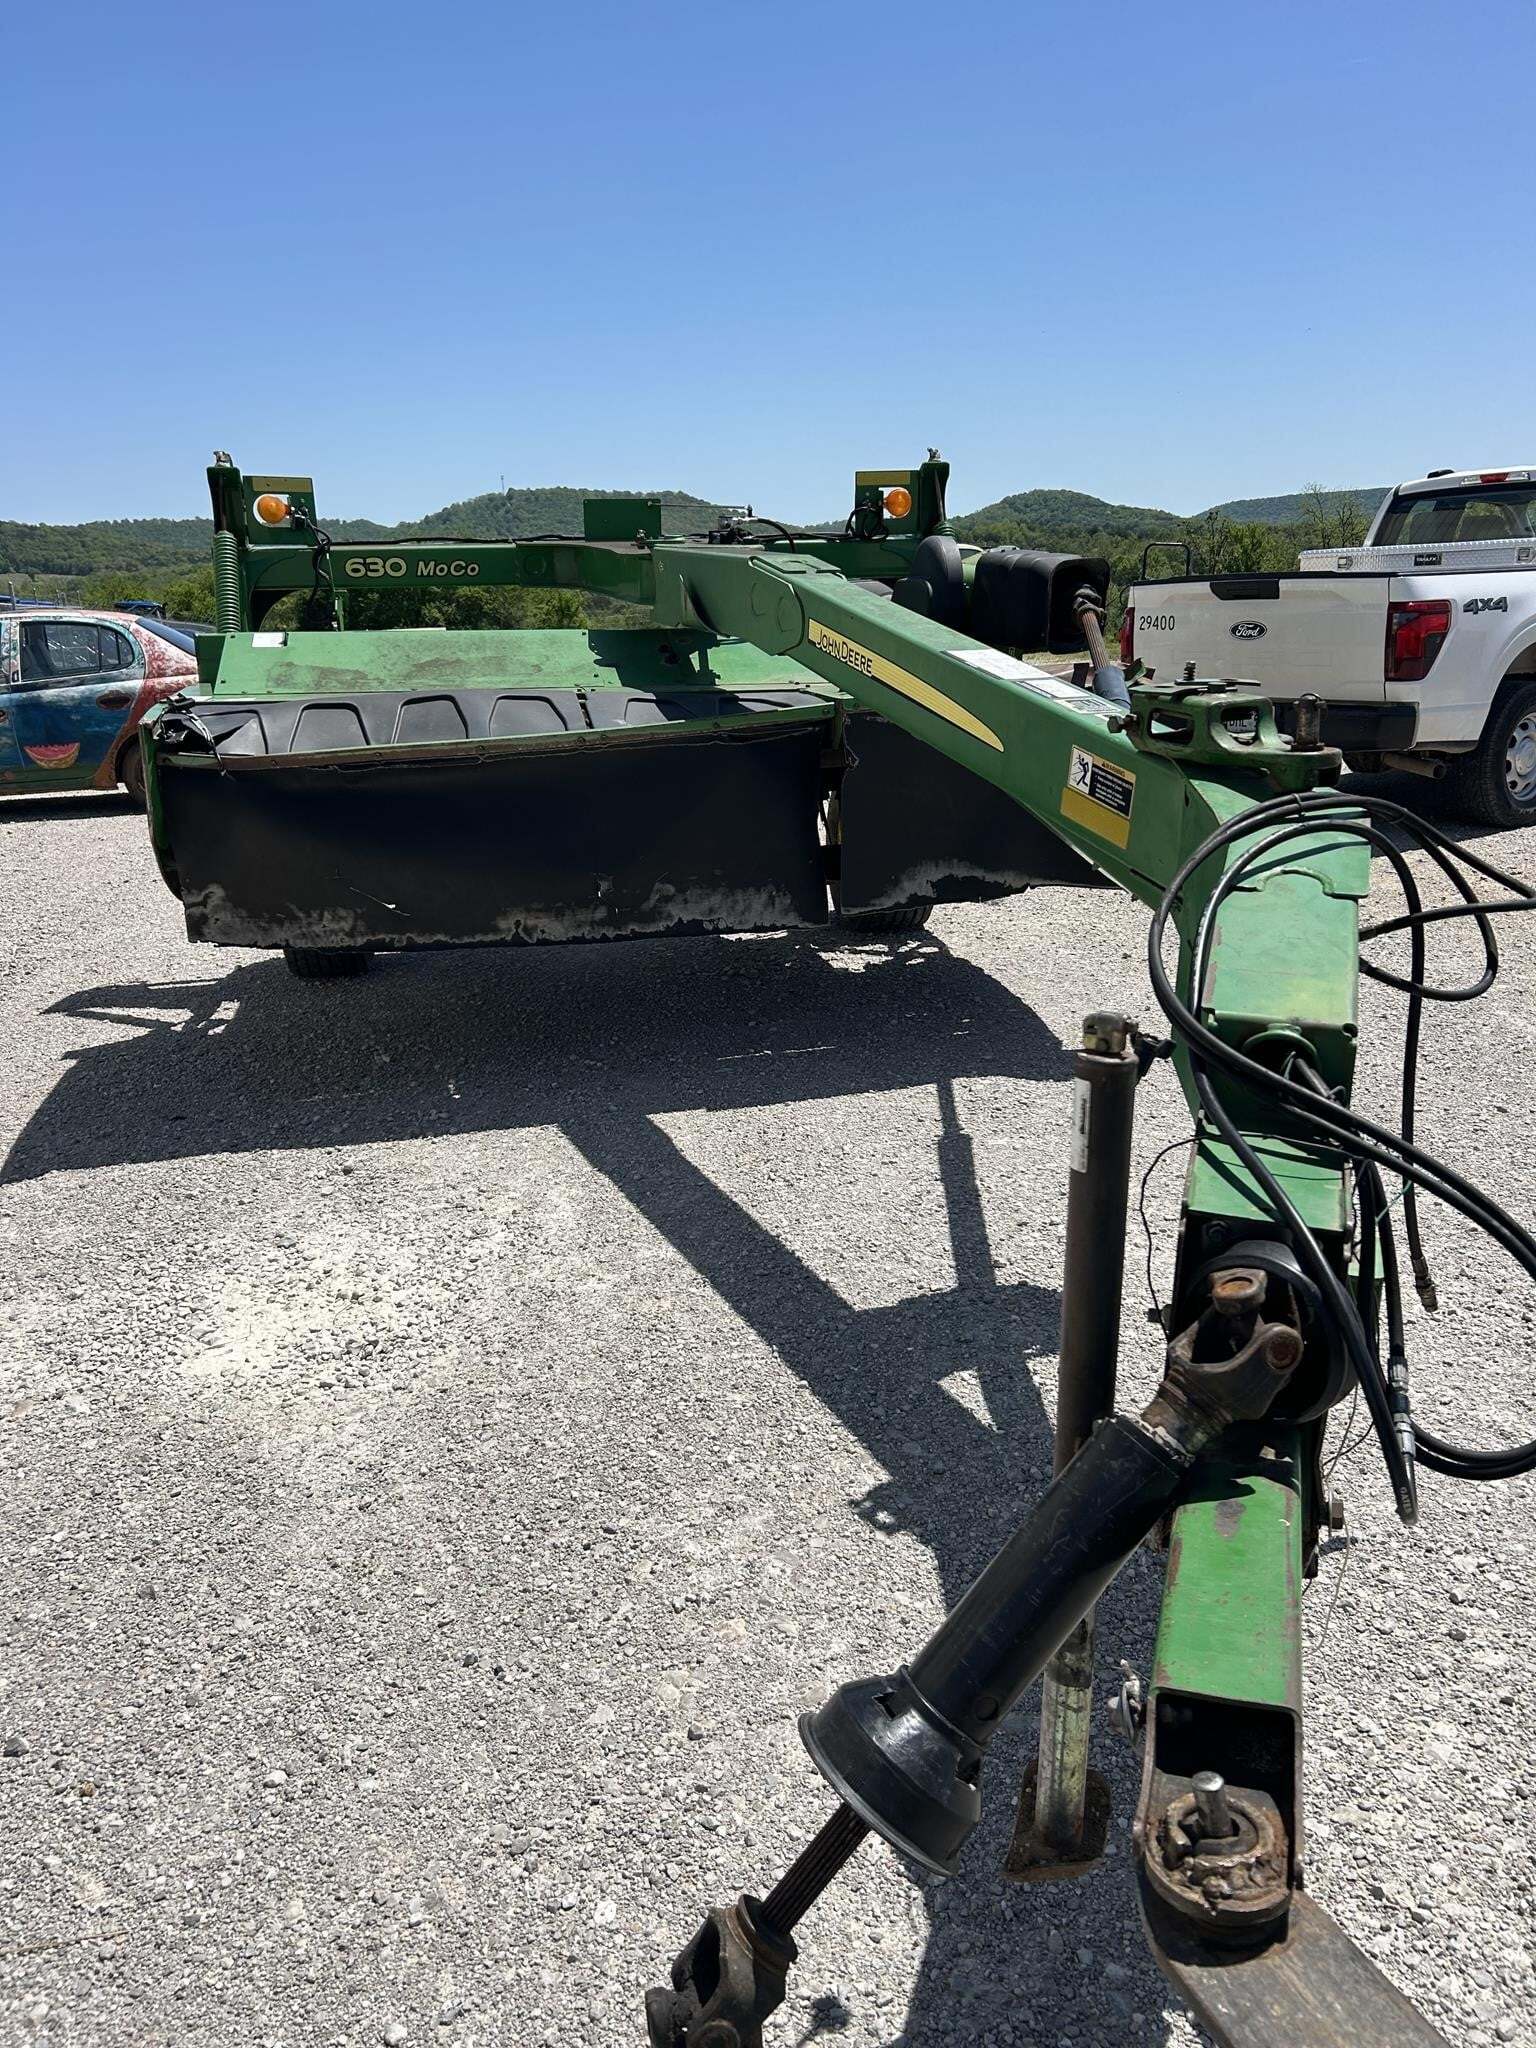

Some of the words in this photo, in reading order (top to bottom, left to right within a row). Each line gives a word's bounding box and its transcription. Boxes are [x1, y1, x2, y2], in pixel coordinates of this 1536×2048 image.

[345, 557, 407, 578] 630
[416, 560, 480, 577] MoCo
[1139, 615, 1176, 631] 29400
